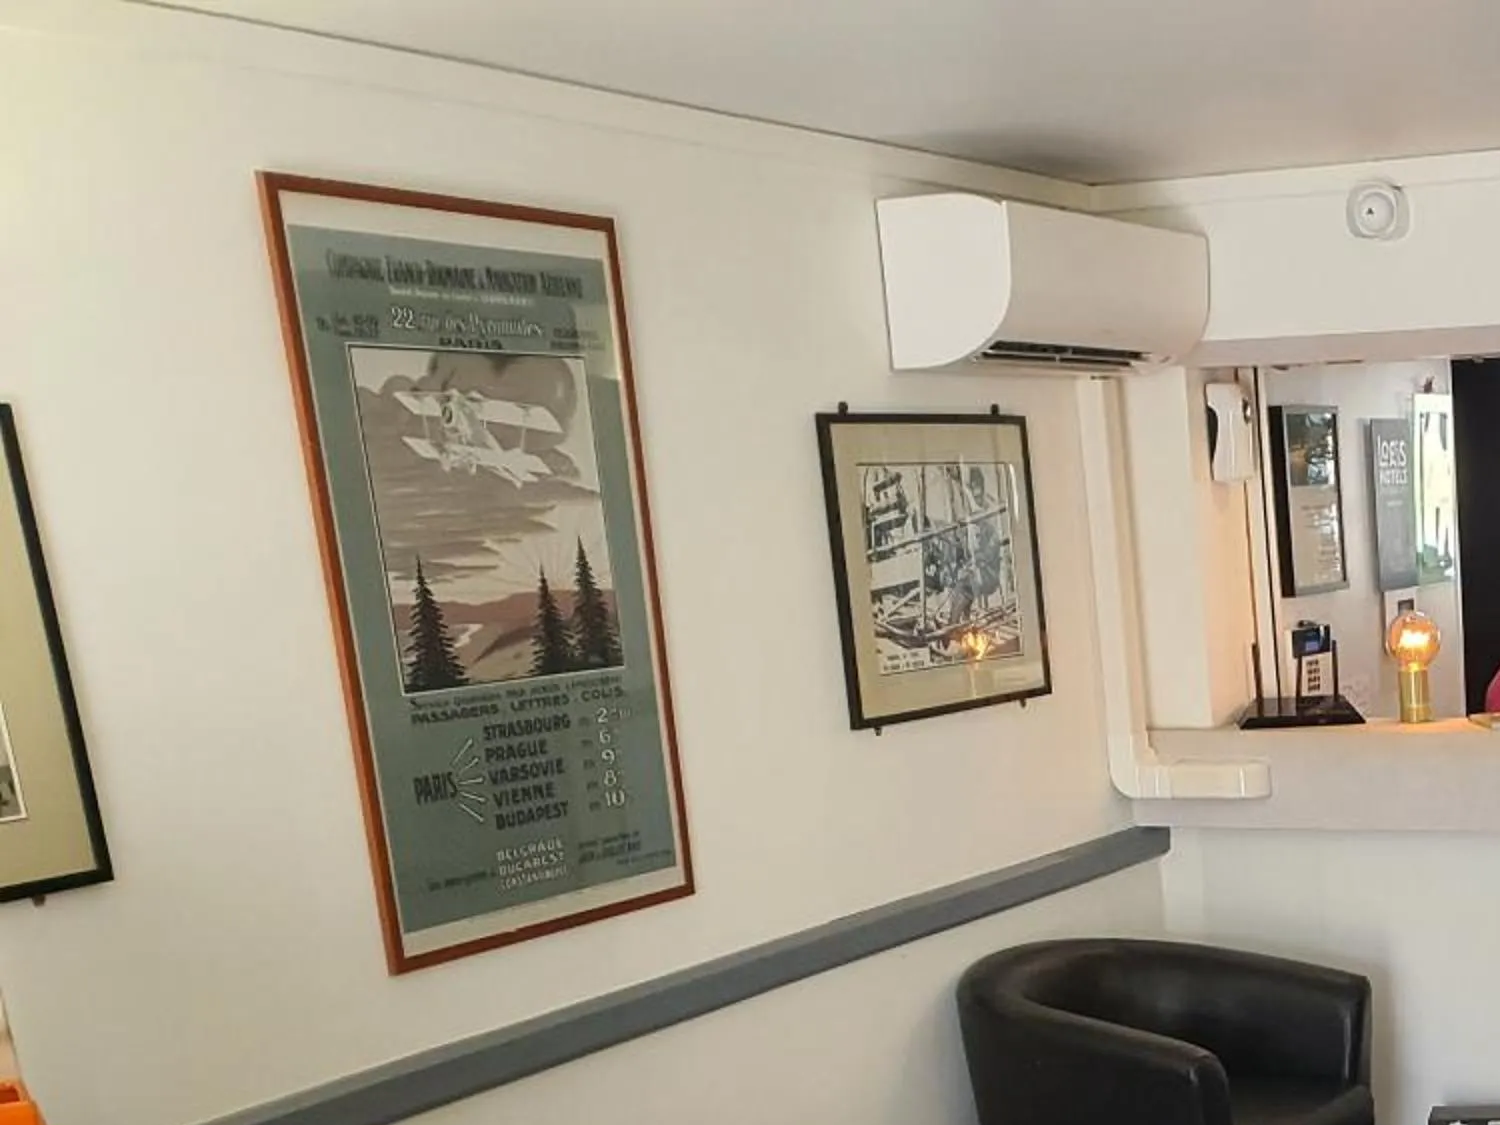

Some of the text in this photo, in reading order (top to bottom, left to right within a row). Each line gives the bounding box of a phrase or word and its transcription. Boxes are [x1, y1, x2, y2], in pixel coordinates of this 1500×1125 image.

[390, 304, 416, 330] 22
[483, 712, 572, 741] STRASBOURG
[484, 739, 549, 763] PRAGUE
[487, 757, 567, 786] VARSOVIE
[413, 770, 459, 806] PARIS
[492, 781, 557, 808] VIENNE
[495, 799, 570, 830] BUDAPEST
